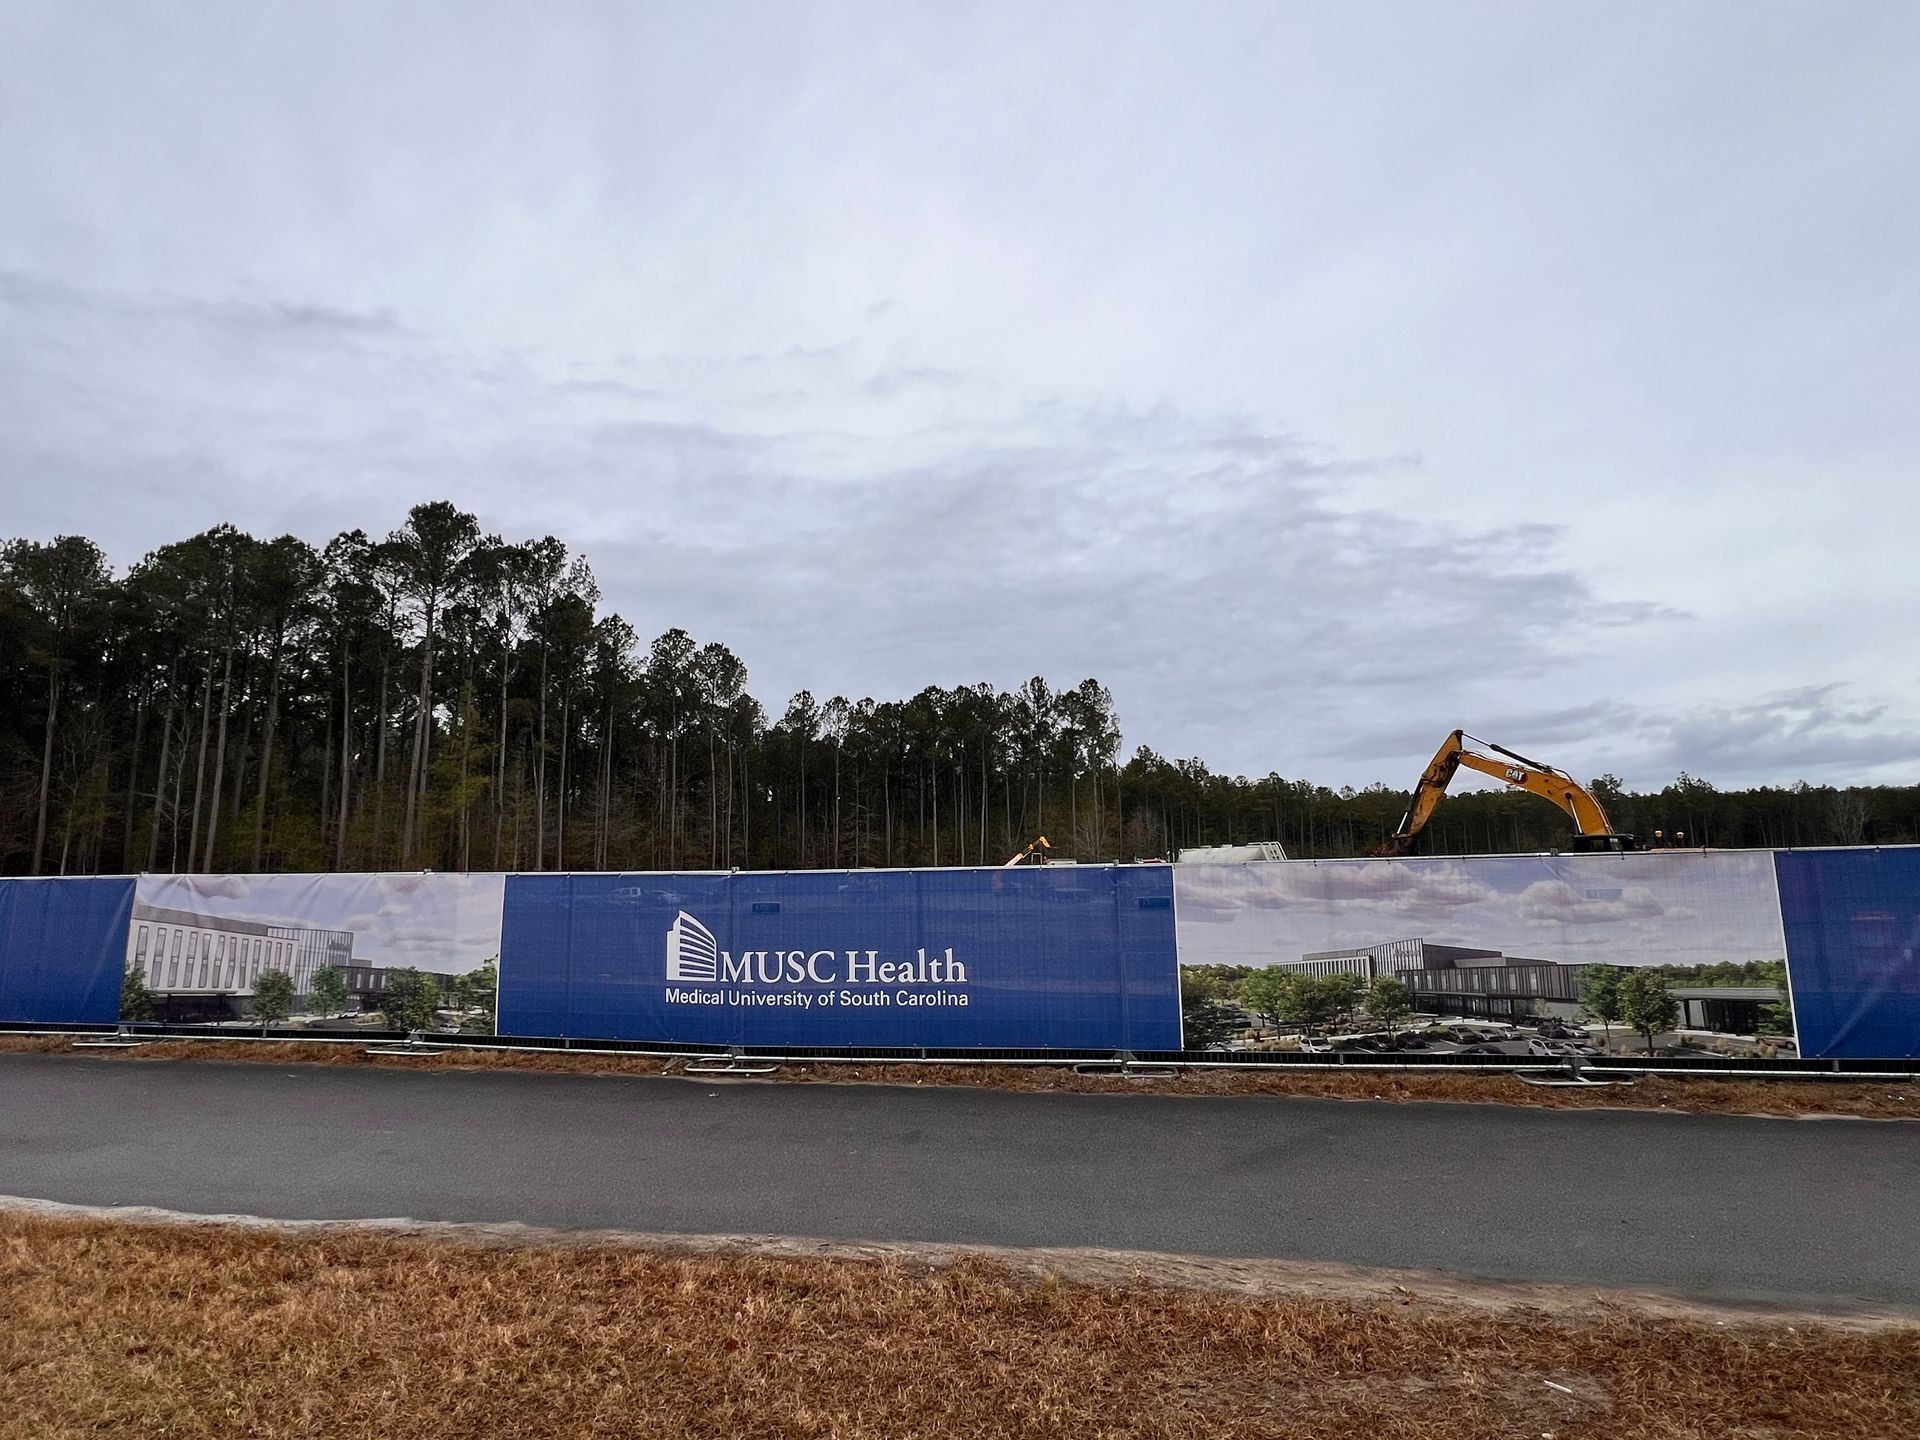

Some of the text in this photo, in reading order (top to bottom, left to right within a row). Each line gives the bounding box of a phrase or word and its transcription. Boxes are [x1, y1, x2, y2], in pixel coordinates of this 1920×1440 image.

[1505, 768, 1525, 781] CAT
[719, 947, 968, 983] MUSC Health
[665, 987, 969, 1010] Medical University of South Carolina
